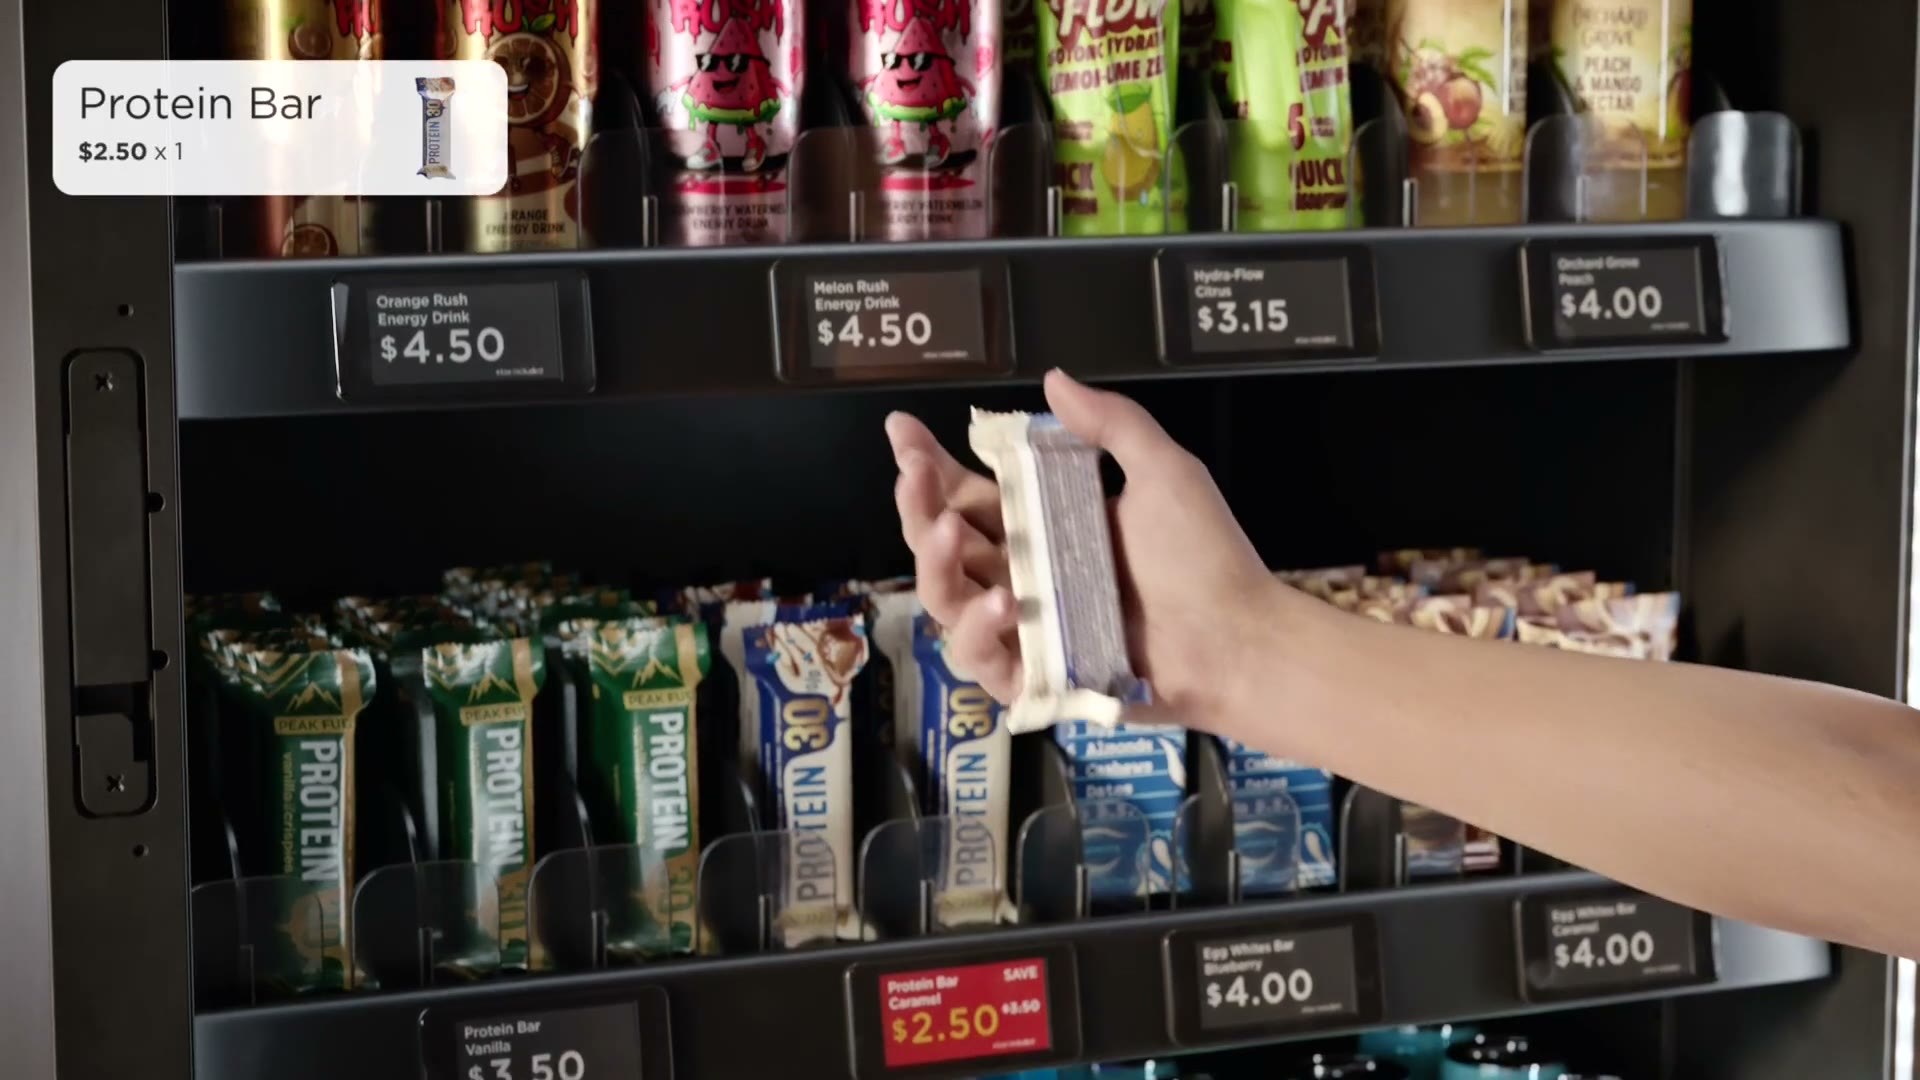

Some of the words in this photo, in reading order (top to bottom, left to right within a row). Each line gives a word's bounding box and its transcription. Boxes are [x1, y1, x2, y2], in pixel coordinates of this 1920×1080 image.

[1590, 75, 1642, 93] MANGO
[504, 208, 549, 222] RANGE
[486, 223, 530, 236] ENEGY
[1557, 257, 1604, 271] Orchard
[1605, 256, 1640, 269] Grove
[1194, 268, 1264, 284] Hydra-Flow
[1558, 273, 1594, 286] Peach
[813, 281, 853, 294] Melon
[857, 279, 889, 293] Rush
[1195, 286, 1232, 298] Citrus
[376, 294, 429, 309] Orange
[433, 293, 468, 307] Rush
[815, 298, 862, 312] Energy
[864, 296, 900, 310] Drink
[1561, 286, 1662, 319] $4.00
[378, 312, 428, 327] Energy
[432, 310, 470, 324] Drink
[1198, 300, 1289, 333] $3.15
[817, 312, 932, 347] $4.50
[381, 327, 505, 363] $4.50
[628, 692, 662, 706] PEAK
[464, 707, 499, 722] PEAK
[949, 686, 994, 737] 30
[278, 718, 320, 731] PEAK
[783, 699, 831, 750] 30
[1086, 738, 1154, 758] Almonds
[1085, 761, 1153, 778] Cashews
[650, 712, 688, 850] PROTEIN
[486, 727, 524, 866] PROTEIN
[300, 740, 339, 881] PROTEIN
[955, 751, 989, 888] PROTEIN
[793, 765, 828, 902] PROTEIN
[1551, 909, 1576, 923] Egg
[1576, 904, 1615, 919] Whites
[1616, 902, 1637, 915] Bar
[1552, 920, 1599, 937] Caramel
[1203, 947, 1229, 961] Egg
[1230, 942, 1271, 956] Whites
[1273, 939, 1295, 952] Bar
[1554, 930, 1654, 968] $4.00
[1003, 965, 1038, 981] SAVE
[1204, 959, 1263, 976] Blueberry
[887, 976, 934, 994] Protein
[936, 974, 959, 989] Bar
[1206, 968, 1313, 1008] $4.00
[888, 993, 942, 1011] Caramel
[464, 1022, 514, 1040] Protein
[517, 1020, 541, 1035] Bar
[892, 1004, 999, 1044] $2.50
[465, 1040, 511, 1056] Vanilla
[468, 1050, 585, 1080] $350
